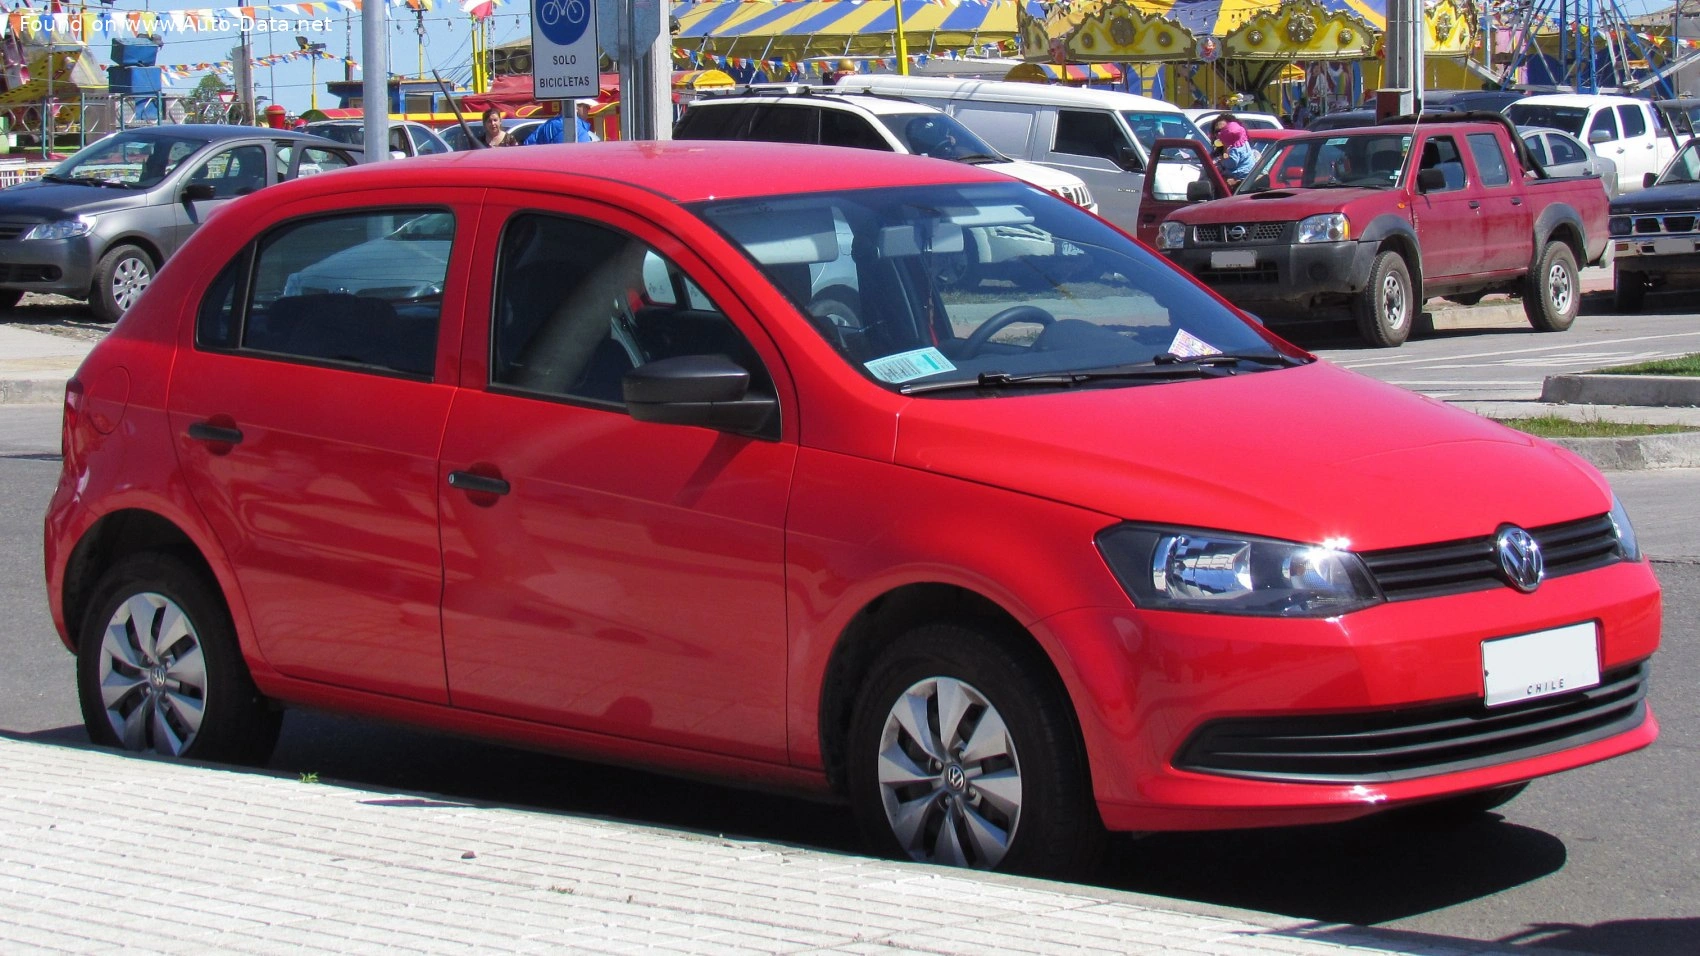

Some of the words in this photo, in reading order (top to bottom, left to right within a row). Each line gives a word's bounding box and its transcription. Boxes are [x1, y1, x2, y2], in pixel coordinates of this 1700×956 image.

[552, 54, 577, 66] SOLO
[539, 75, 590, 88] BICICLETAS
[1526, 678, 1565, 695] CHILE
